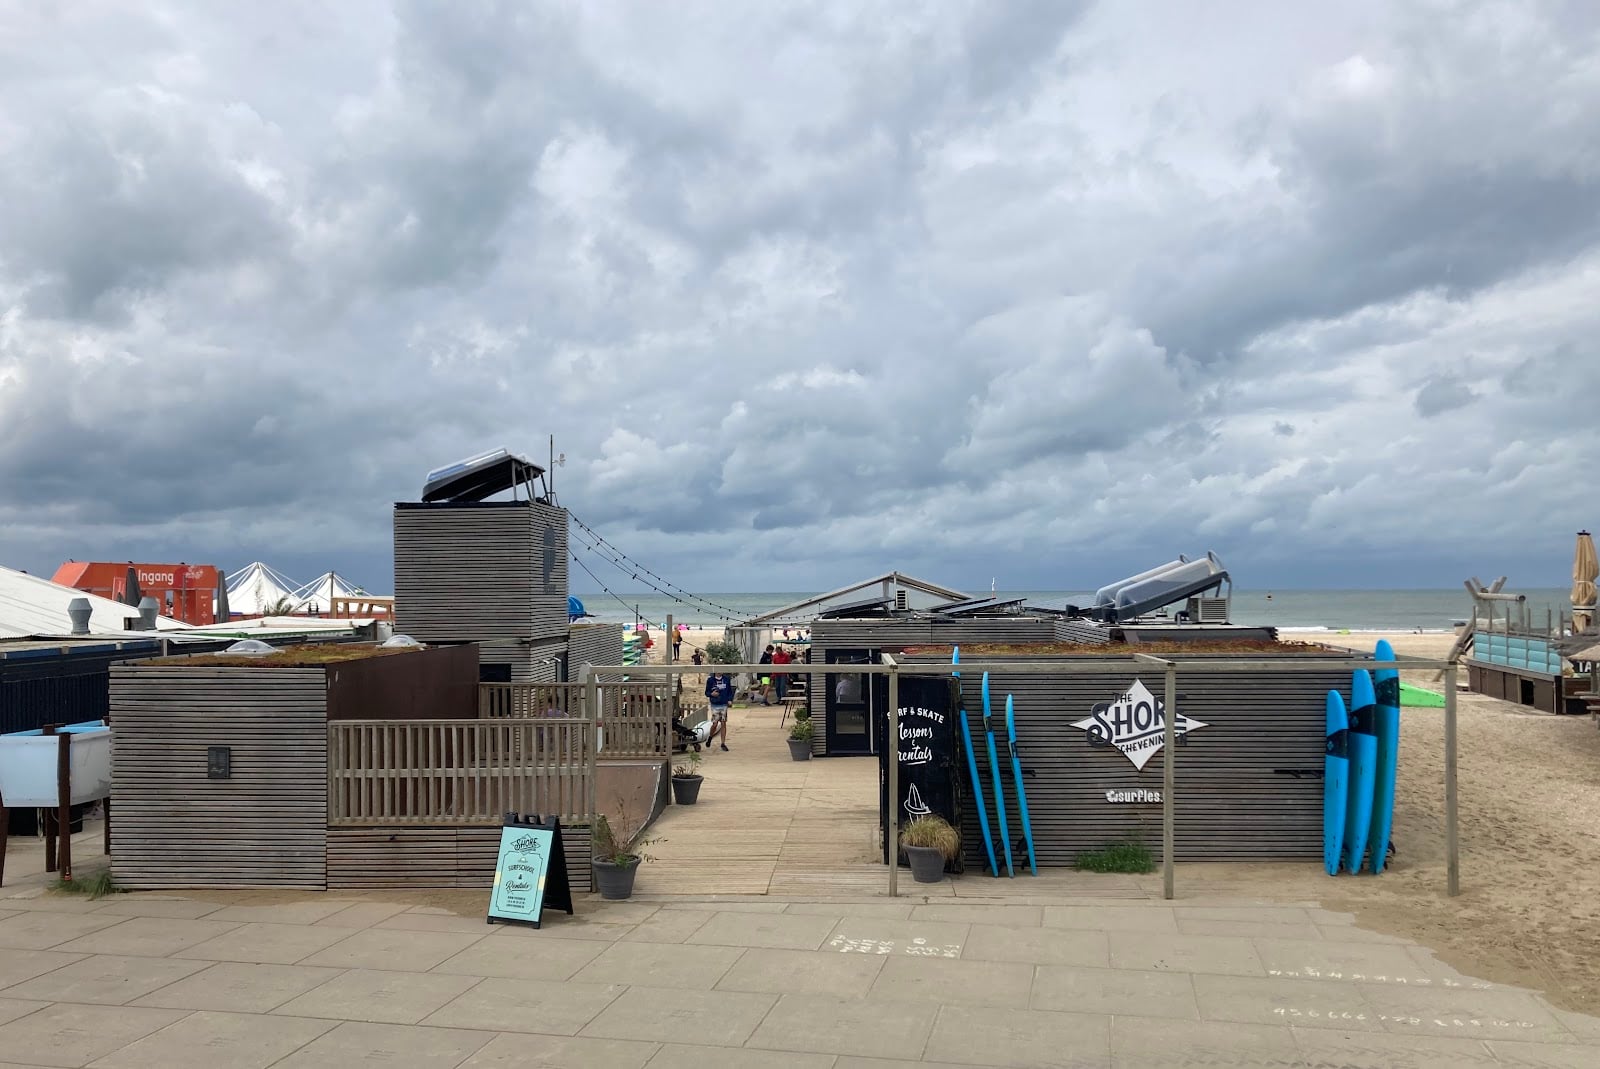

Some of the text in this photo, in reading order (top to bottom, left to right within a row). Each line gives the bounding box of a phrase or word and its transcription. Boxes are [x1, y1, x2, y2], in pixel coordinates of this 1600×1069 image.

[138, 570, 174, 585] Ingang
[1113, 692, 1133, 704] THE
[887, 707, 908, 720] SRF
[917, 707, 945, 724] SKATE
[1086, 694, 1187, 749] SHORE
[898, 722, 933, 740] lessons
[898, 745, 933, 762] rentals
[514, 837, 539, 851] SHORE
